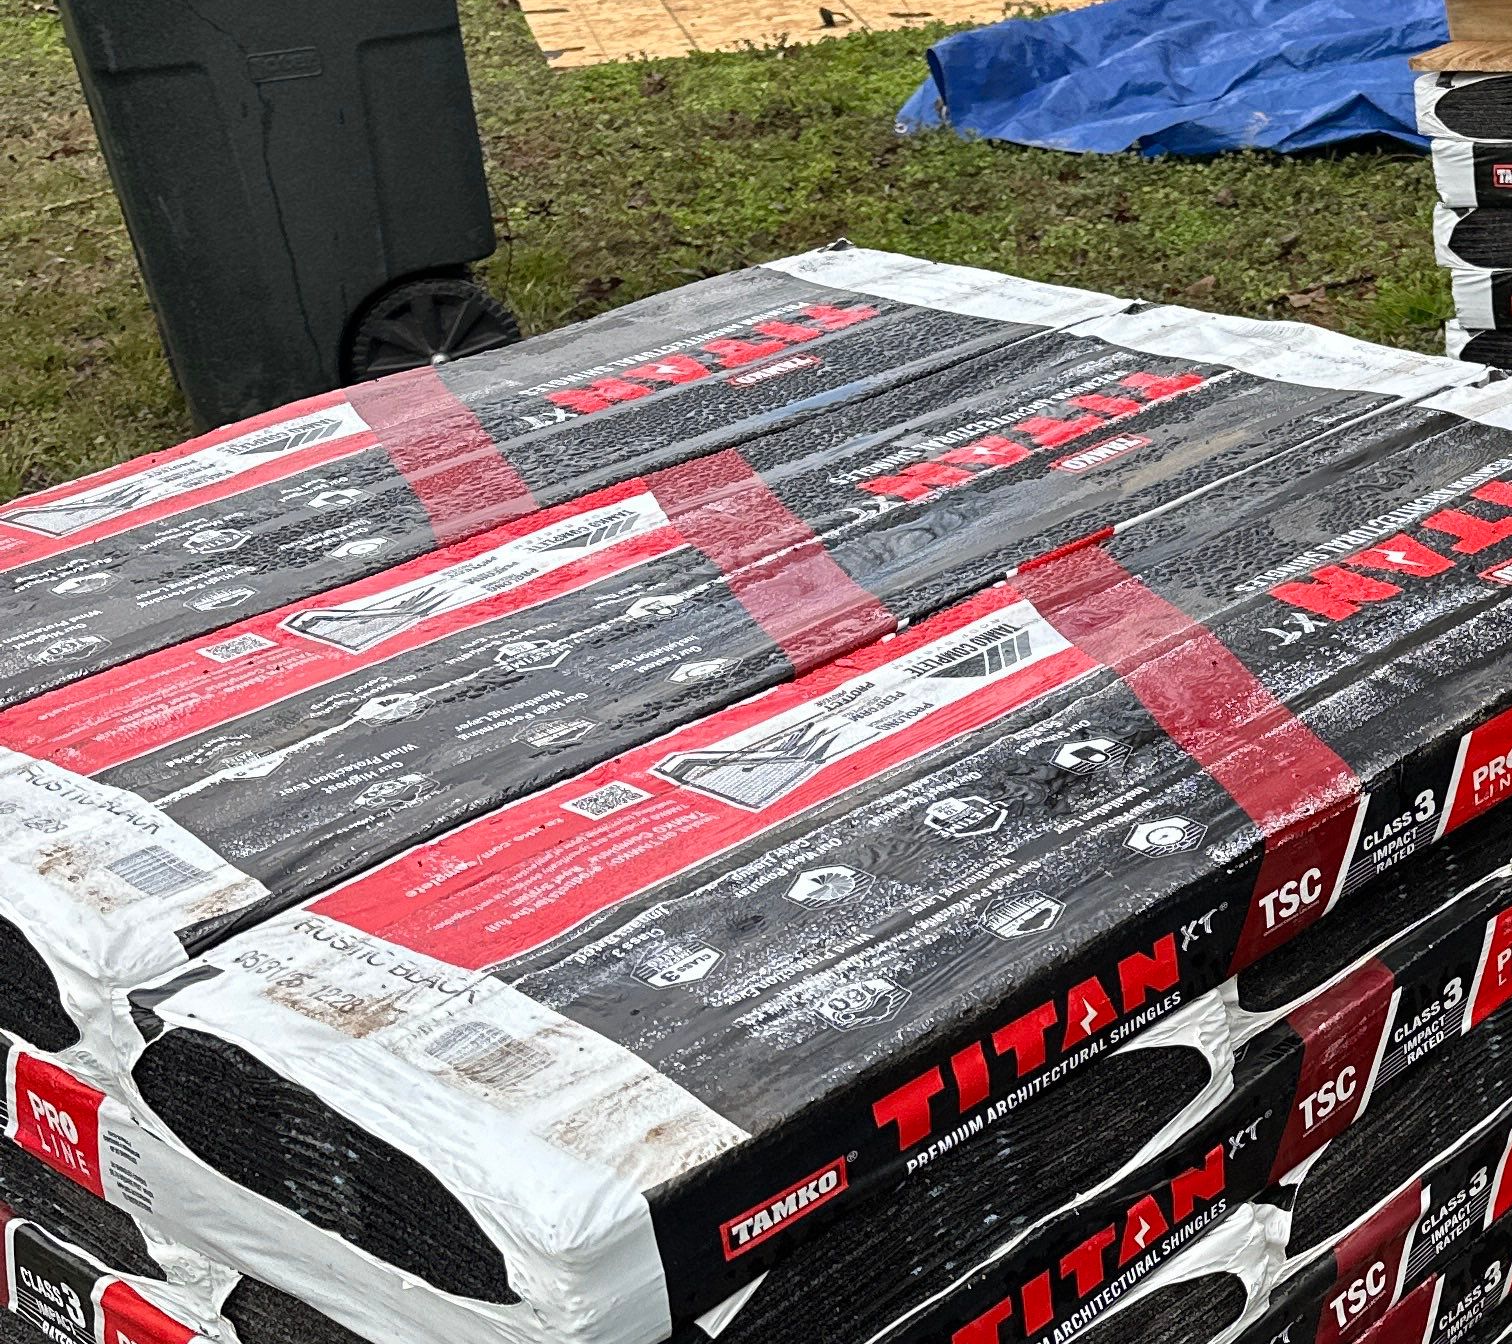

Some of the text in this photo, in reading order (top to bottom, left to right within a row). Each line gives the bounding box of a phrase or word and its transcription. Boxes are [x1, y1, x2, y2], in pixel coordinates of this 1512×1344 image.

[1060, 436, 1142, 471] TAMKO
[903, 624, 1020, 677] TAMKO COMPLETE
[823, 681, 875, 712] PROTECT
[1363, 788, 1436, 851] CLASS 3
[1371, 827, 1418, 864] IMPACT
[1375, 843, 1416, 874] RATED
[1258, 867, 1322, 929] TSC
[1394, 977, 1463, 1043] CLASS 3
[872, 933, 1180, 1152] TITAN
[906, 992, 1182, 1175] PREMIUM ARCHITECTURAL SHINGLES
[1298, 1065, 1357, 1129] TSC
[27, 1089, 78, 1145] PRO
[36, 1126, 90, 1176] LINE
[1161, 1197, 1228, 1256] SHINGLES
[1421, 1166, 1488, 1235] CLASS 3
[19, 1266, 86, 1329] CLASS 3
[1330, 1261, 1386, 1329] TSC
